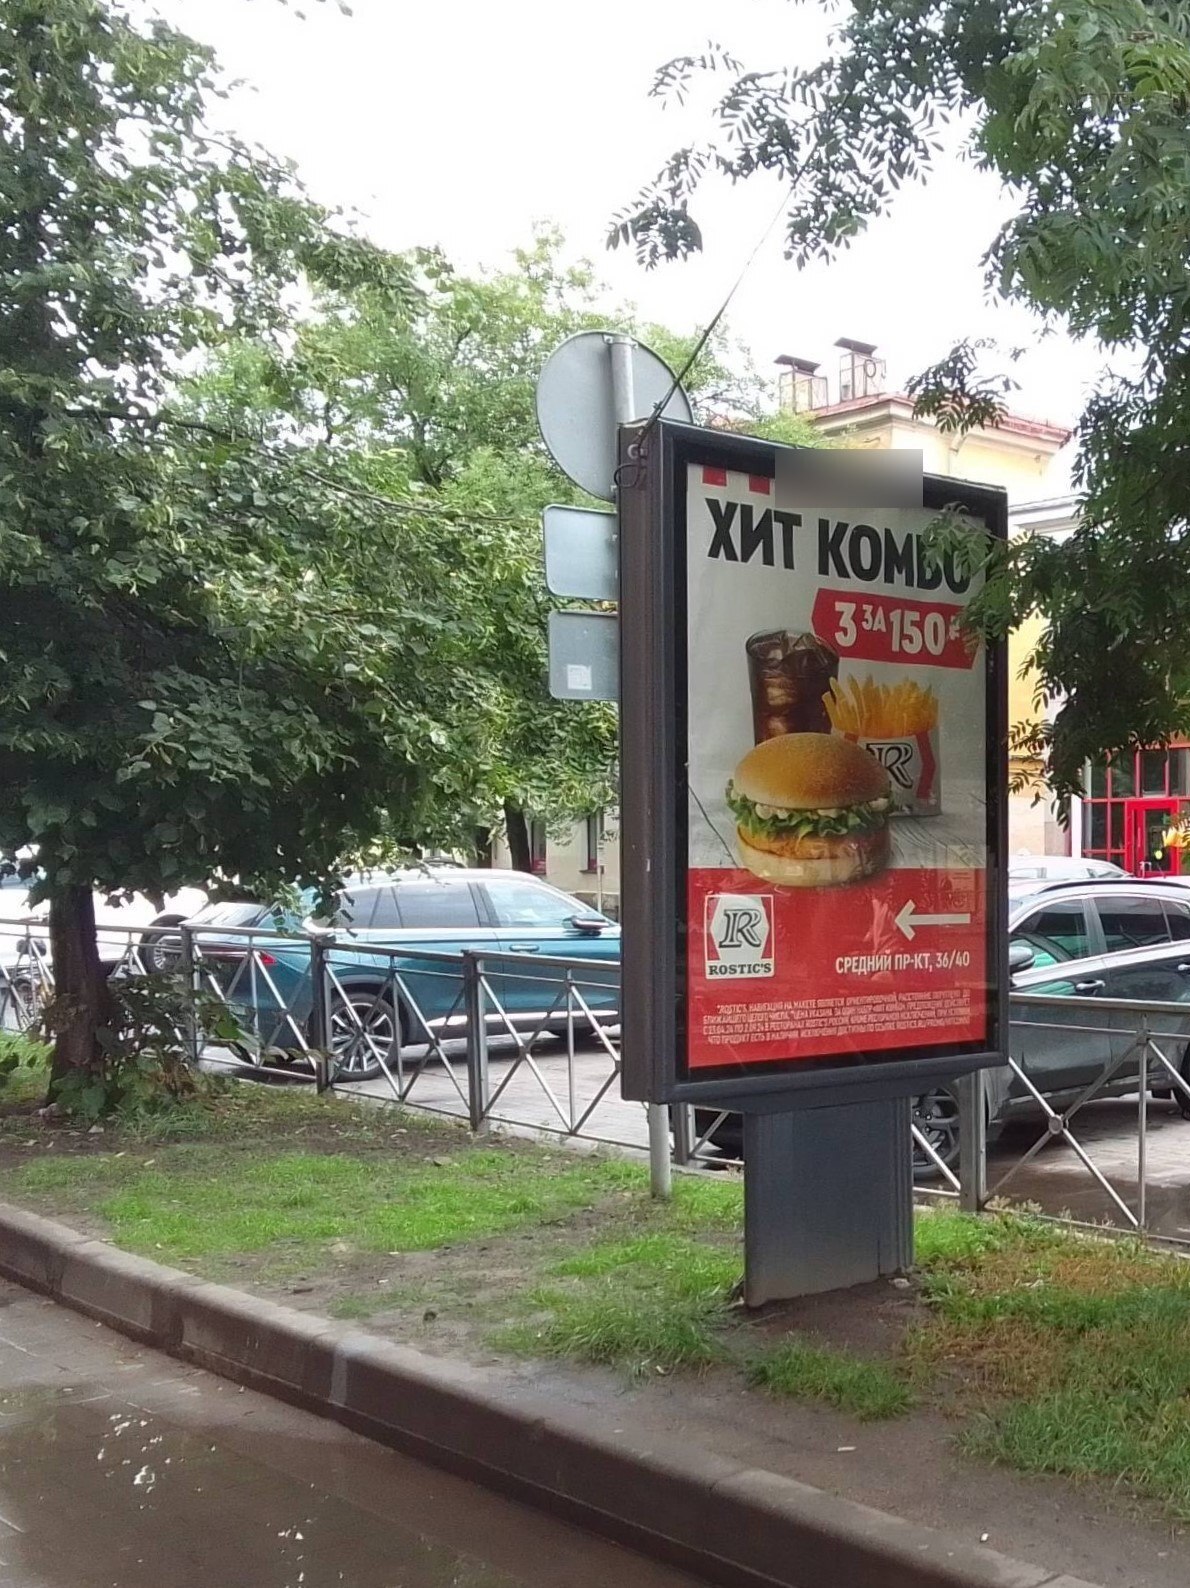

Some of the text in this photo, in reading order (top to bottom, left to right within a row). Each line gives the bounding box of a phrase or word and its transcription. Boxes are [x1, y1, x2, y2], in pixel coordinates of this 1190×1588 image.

[705, 498, 802, 570] ХИТ
[835, 601, 857, 647] 3
[719, 909, 762, 948] R
[708, 962, 772, 976] ROSTIC'S
[835, 949, 970, 975] СРЕДНИЙ ПР-КТ, 36/40
